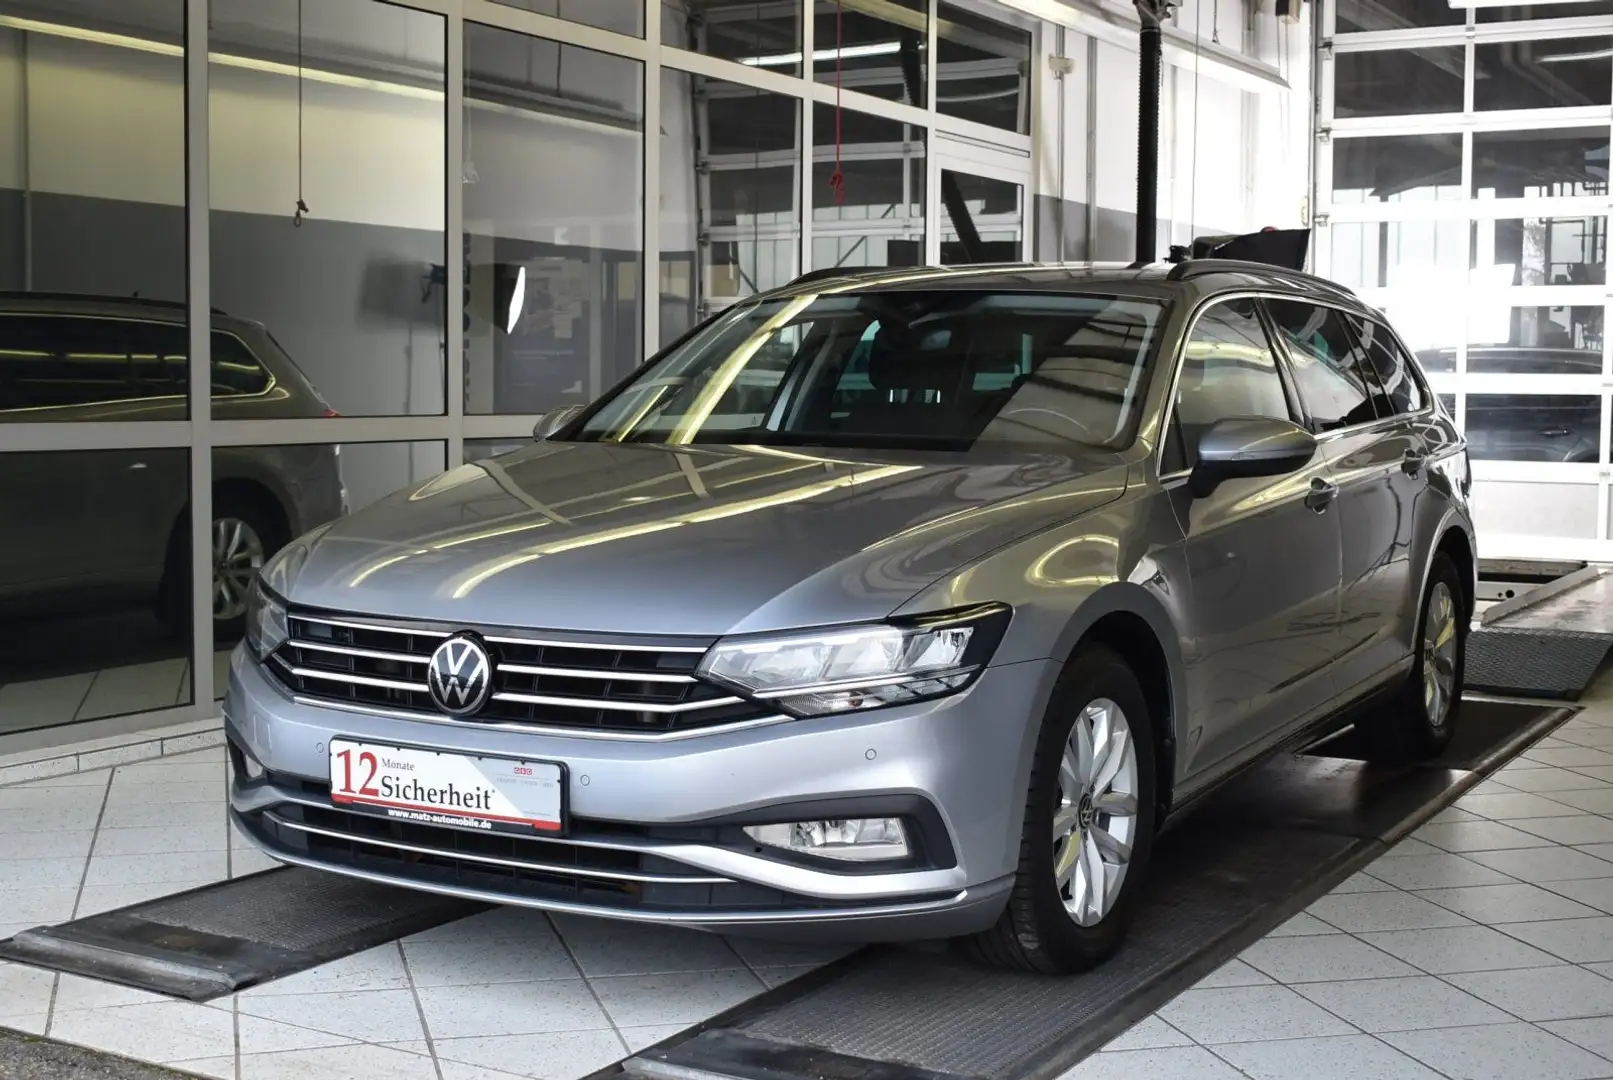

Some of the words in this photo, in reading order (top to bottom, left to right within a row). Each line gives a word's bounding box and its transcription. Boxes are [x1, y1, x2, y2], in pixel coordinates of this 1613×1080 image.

[429, 638, 489, 713] VW
[337, 748, 379, 797] 12
[382, 757, 415, 771] Monate
[381, 775, 490, 810] Sicherheit
[387, 808, 493, 829] www.matz-automobile.de
